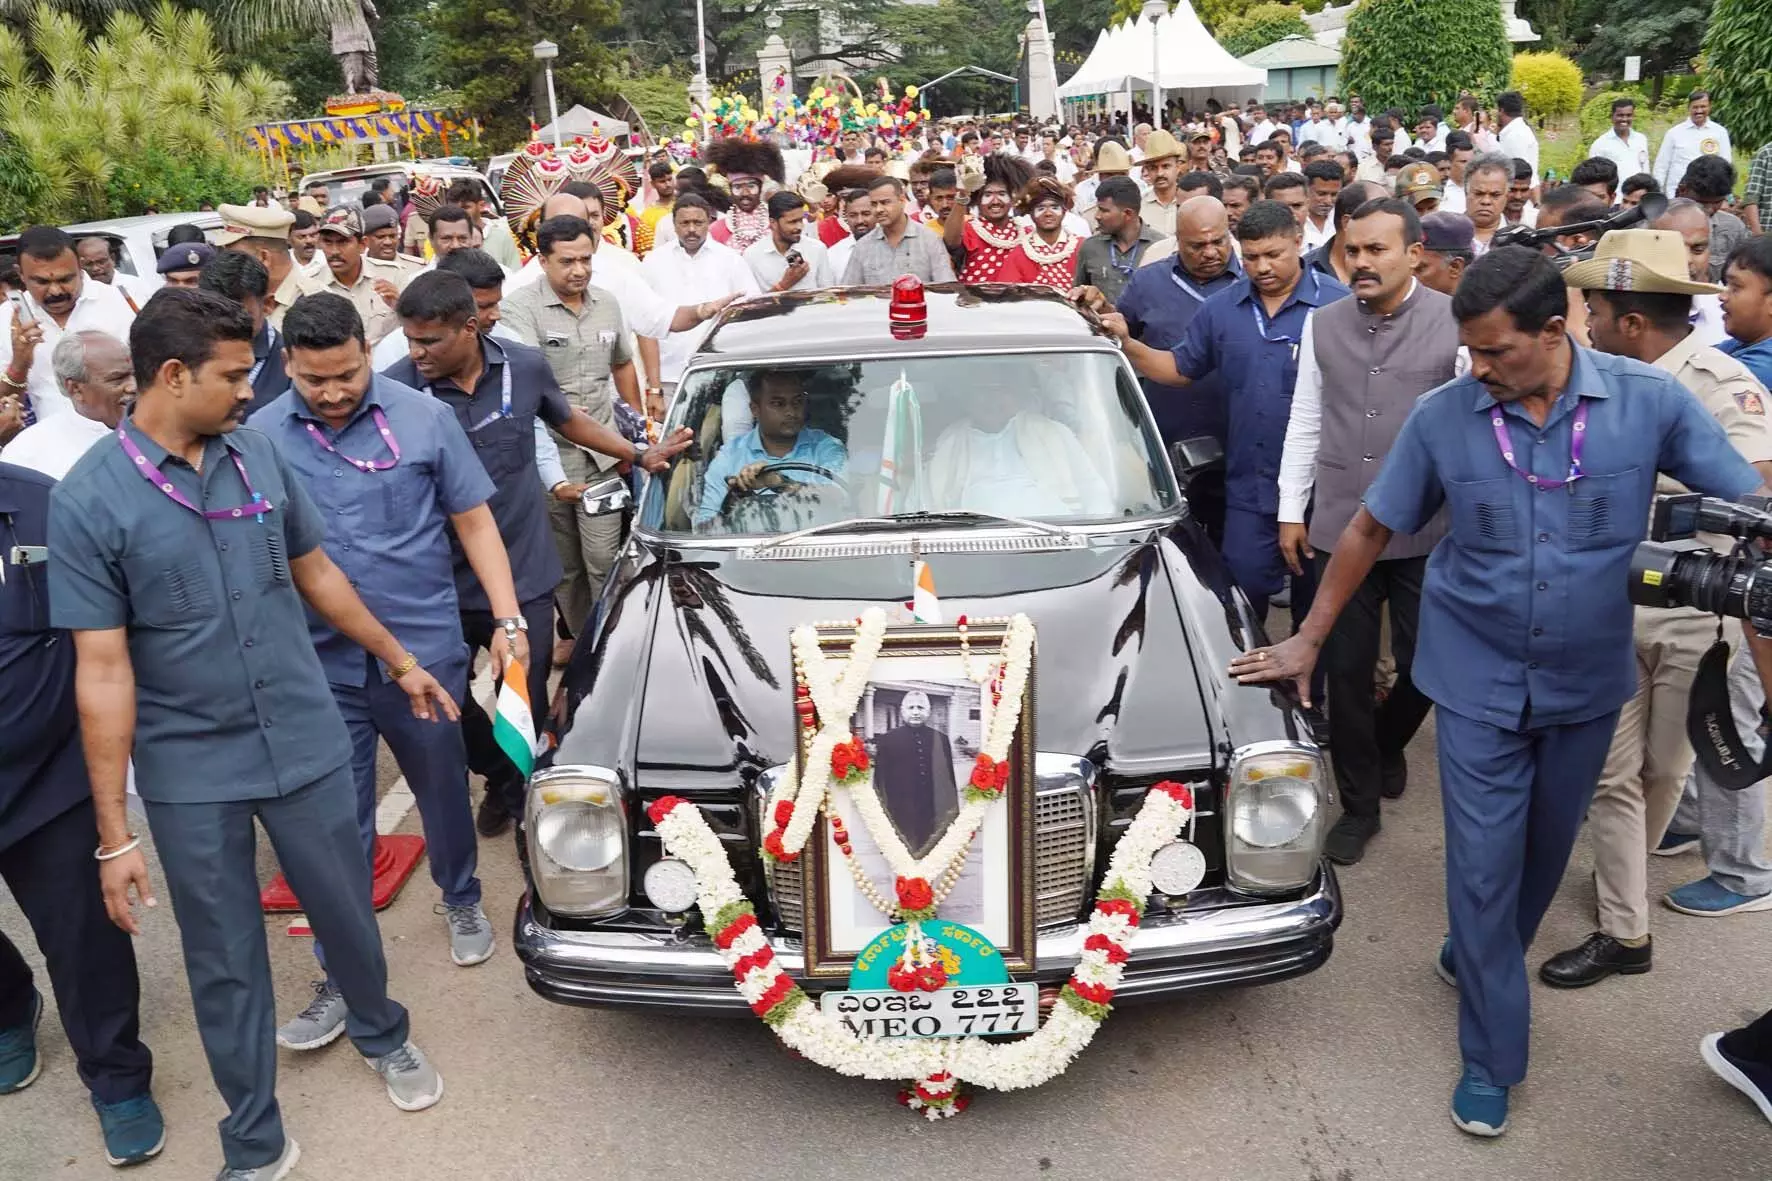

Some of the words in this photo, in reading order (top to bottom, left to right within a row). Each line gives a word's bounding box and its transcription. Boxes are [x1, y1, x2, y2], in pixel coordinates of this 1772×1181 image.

[857, 926, 910, 971] ಕರ್ನಾಟ
[839, 1016, 942, 1039] MEO
[958, 1011, 1025, 1034] 777
